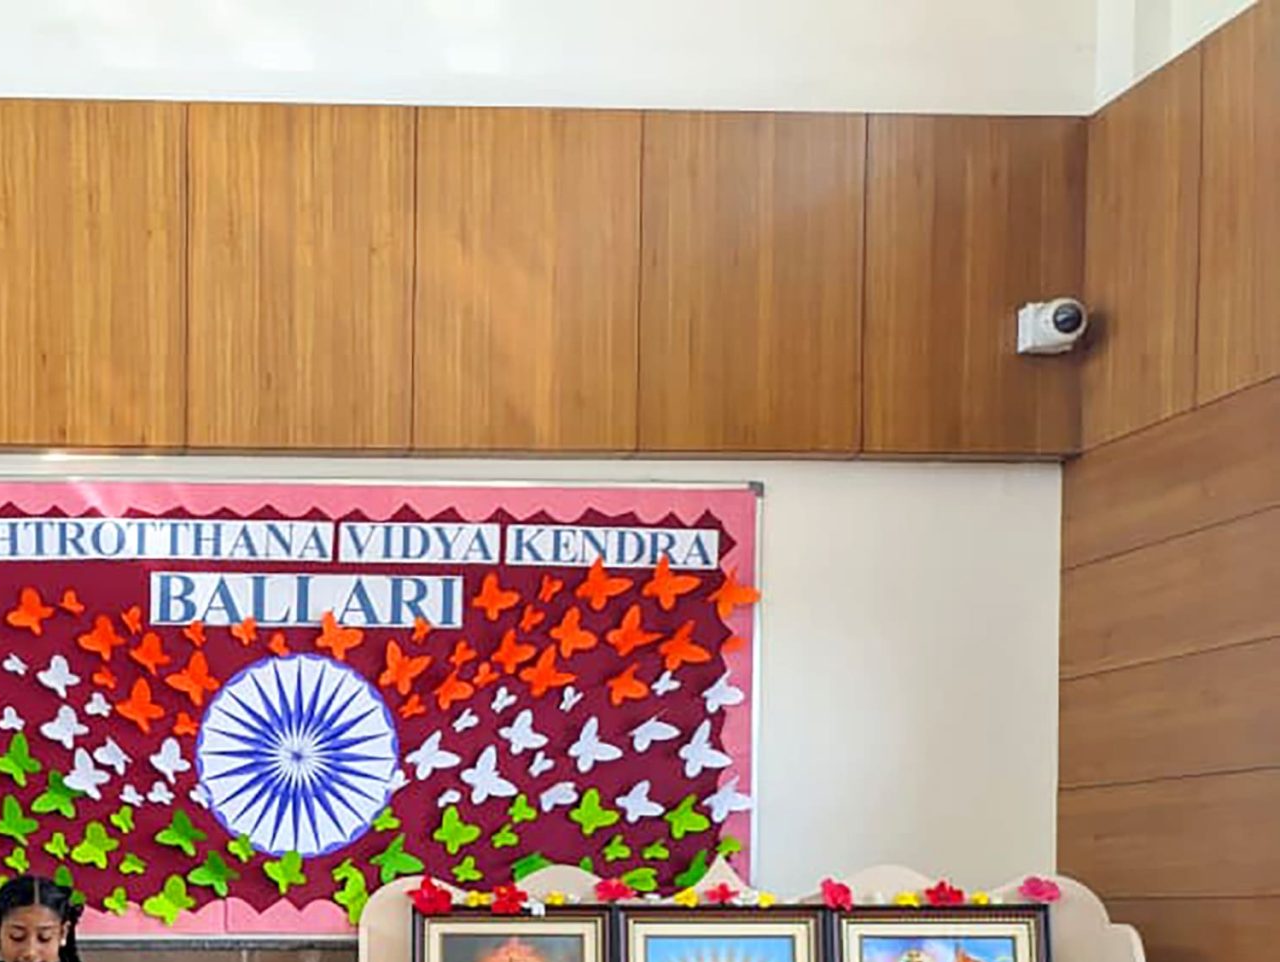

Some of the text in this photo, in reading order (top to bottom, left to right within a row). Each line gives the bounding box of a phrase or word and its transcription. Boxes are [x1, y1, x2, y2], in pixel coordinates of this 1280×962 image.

[346, 524, 494, 561] VIDYA
[514, 527, 713, 566] KENDRA
[157, 574, 455, 626] BALLARI
